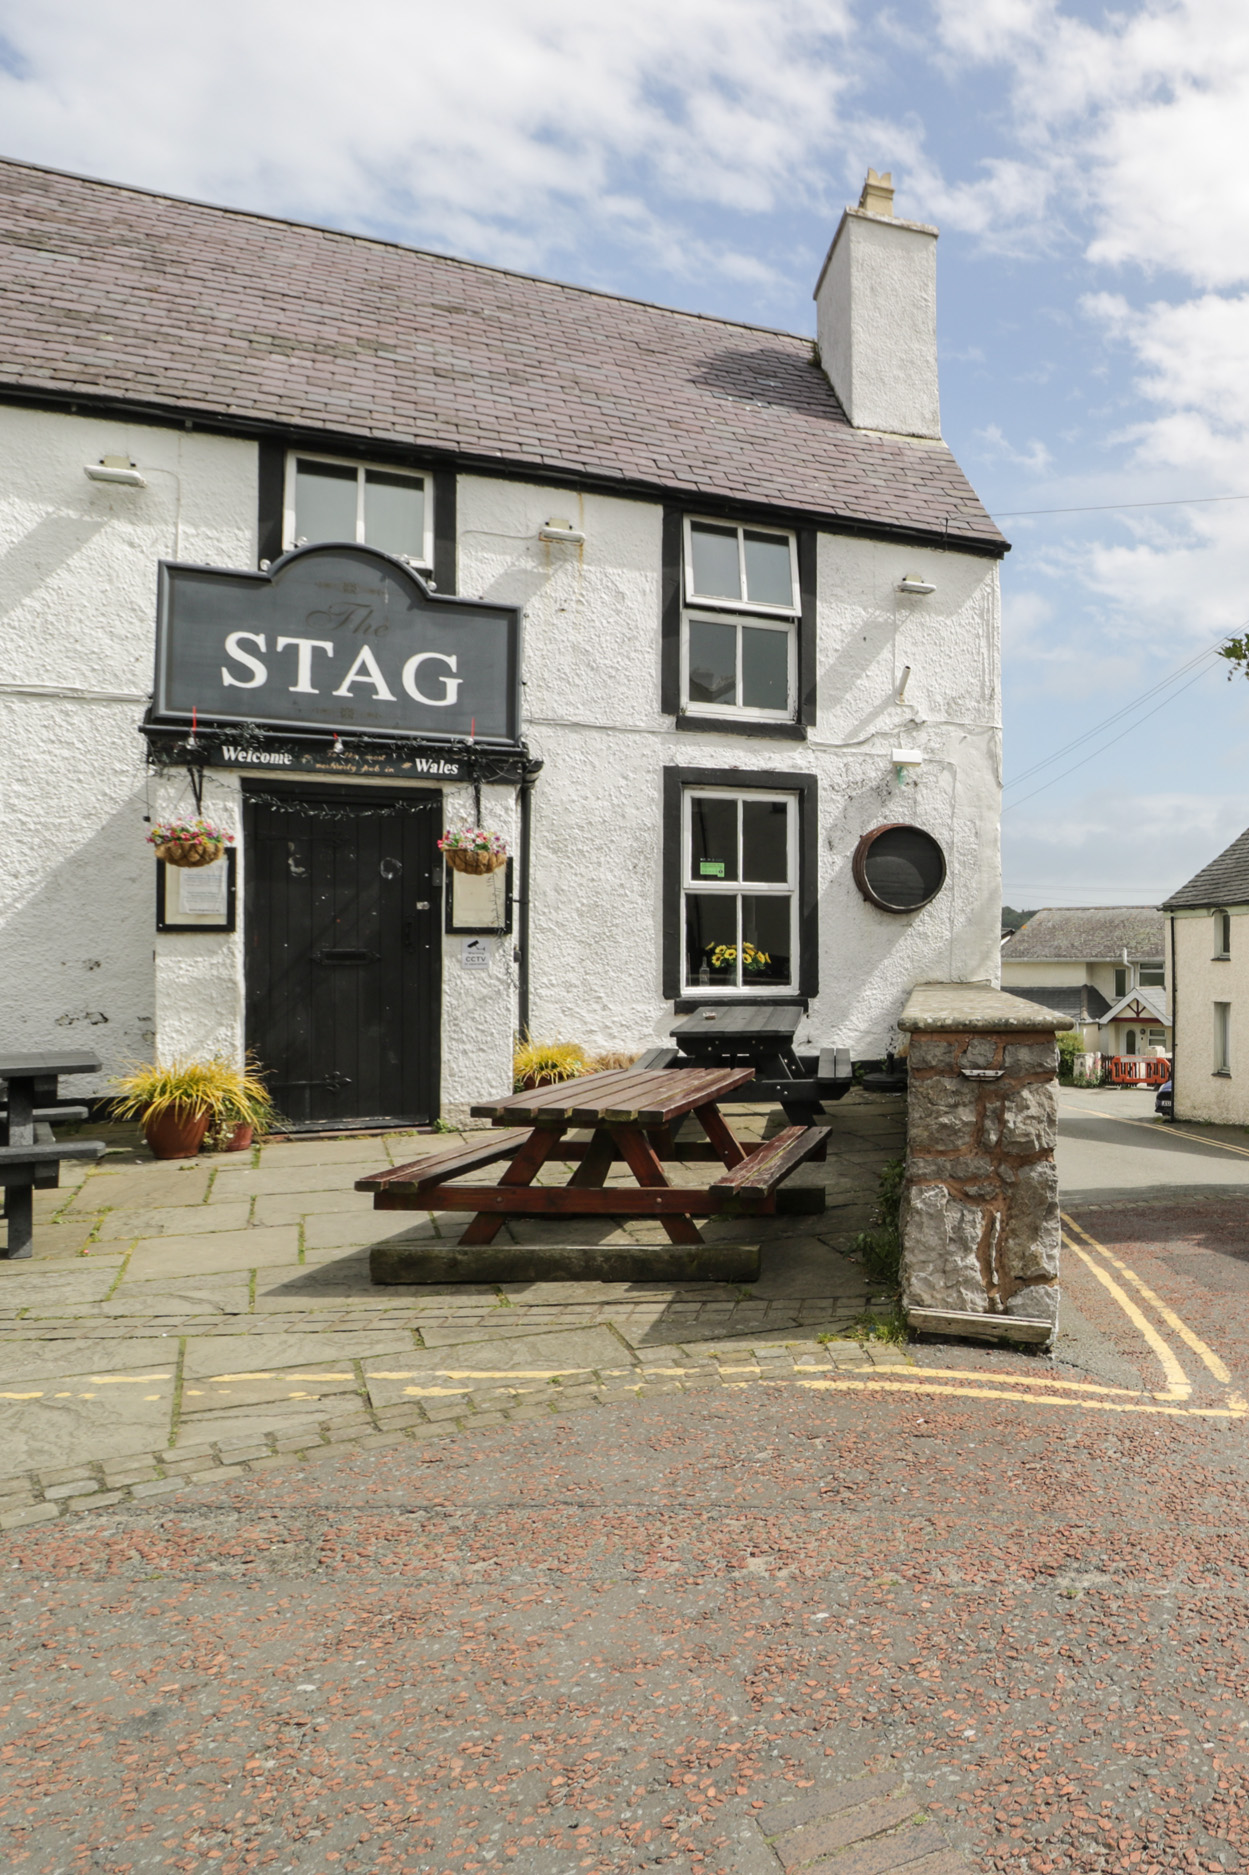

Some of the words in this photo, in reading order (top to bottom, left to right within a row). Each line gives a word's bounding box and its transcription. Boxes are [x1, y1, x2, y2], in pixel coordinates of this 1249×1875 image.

[305, 601, 390, 638] The
[221, 631, 464, 707] STAG
[222, 745, 293, 765] Welcome
[415, 758, 459, 775] Wales
